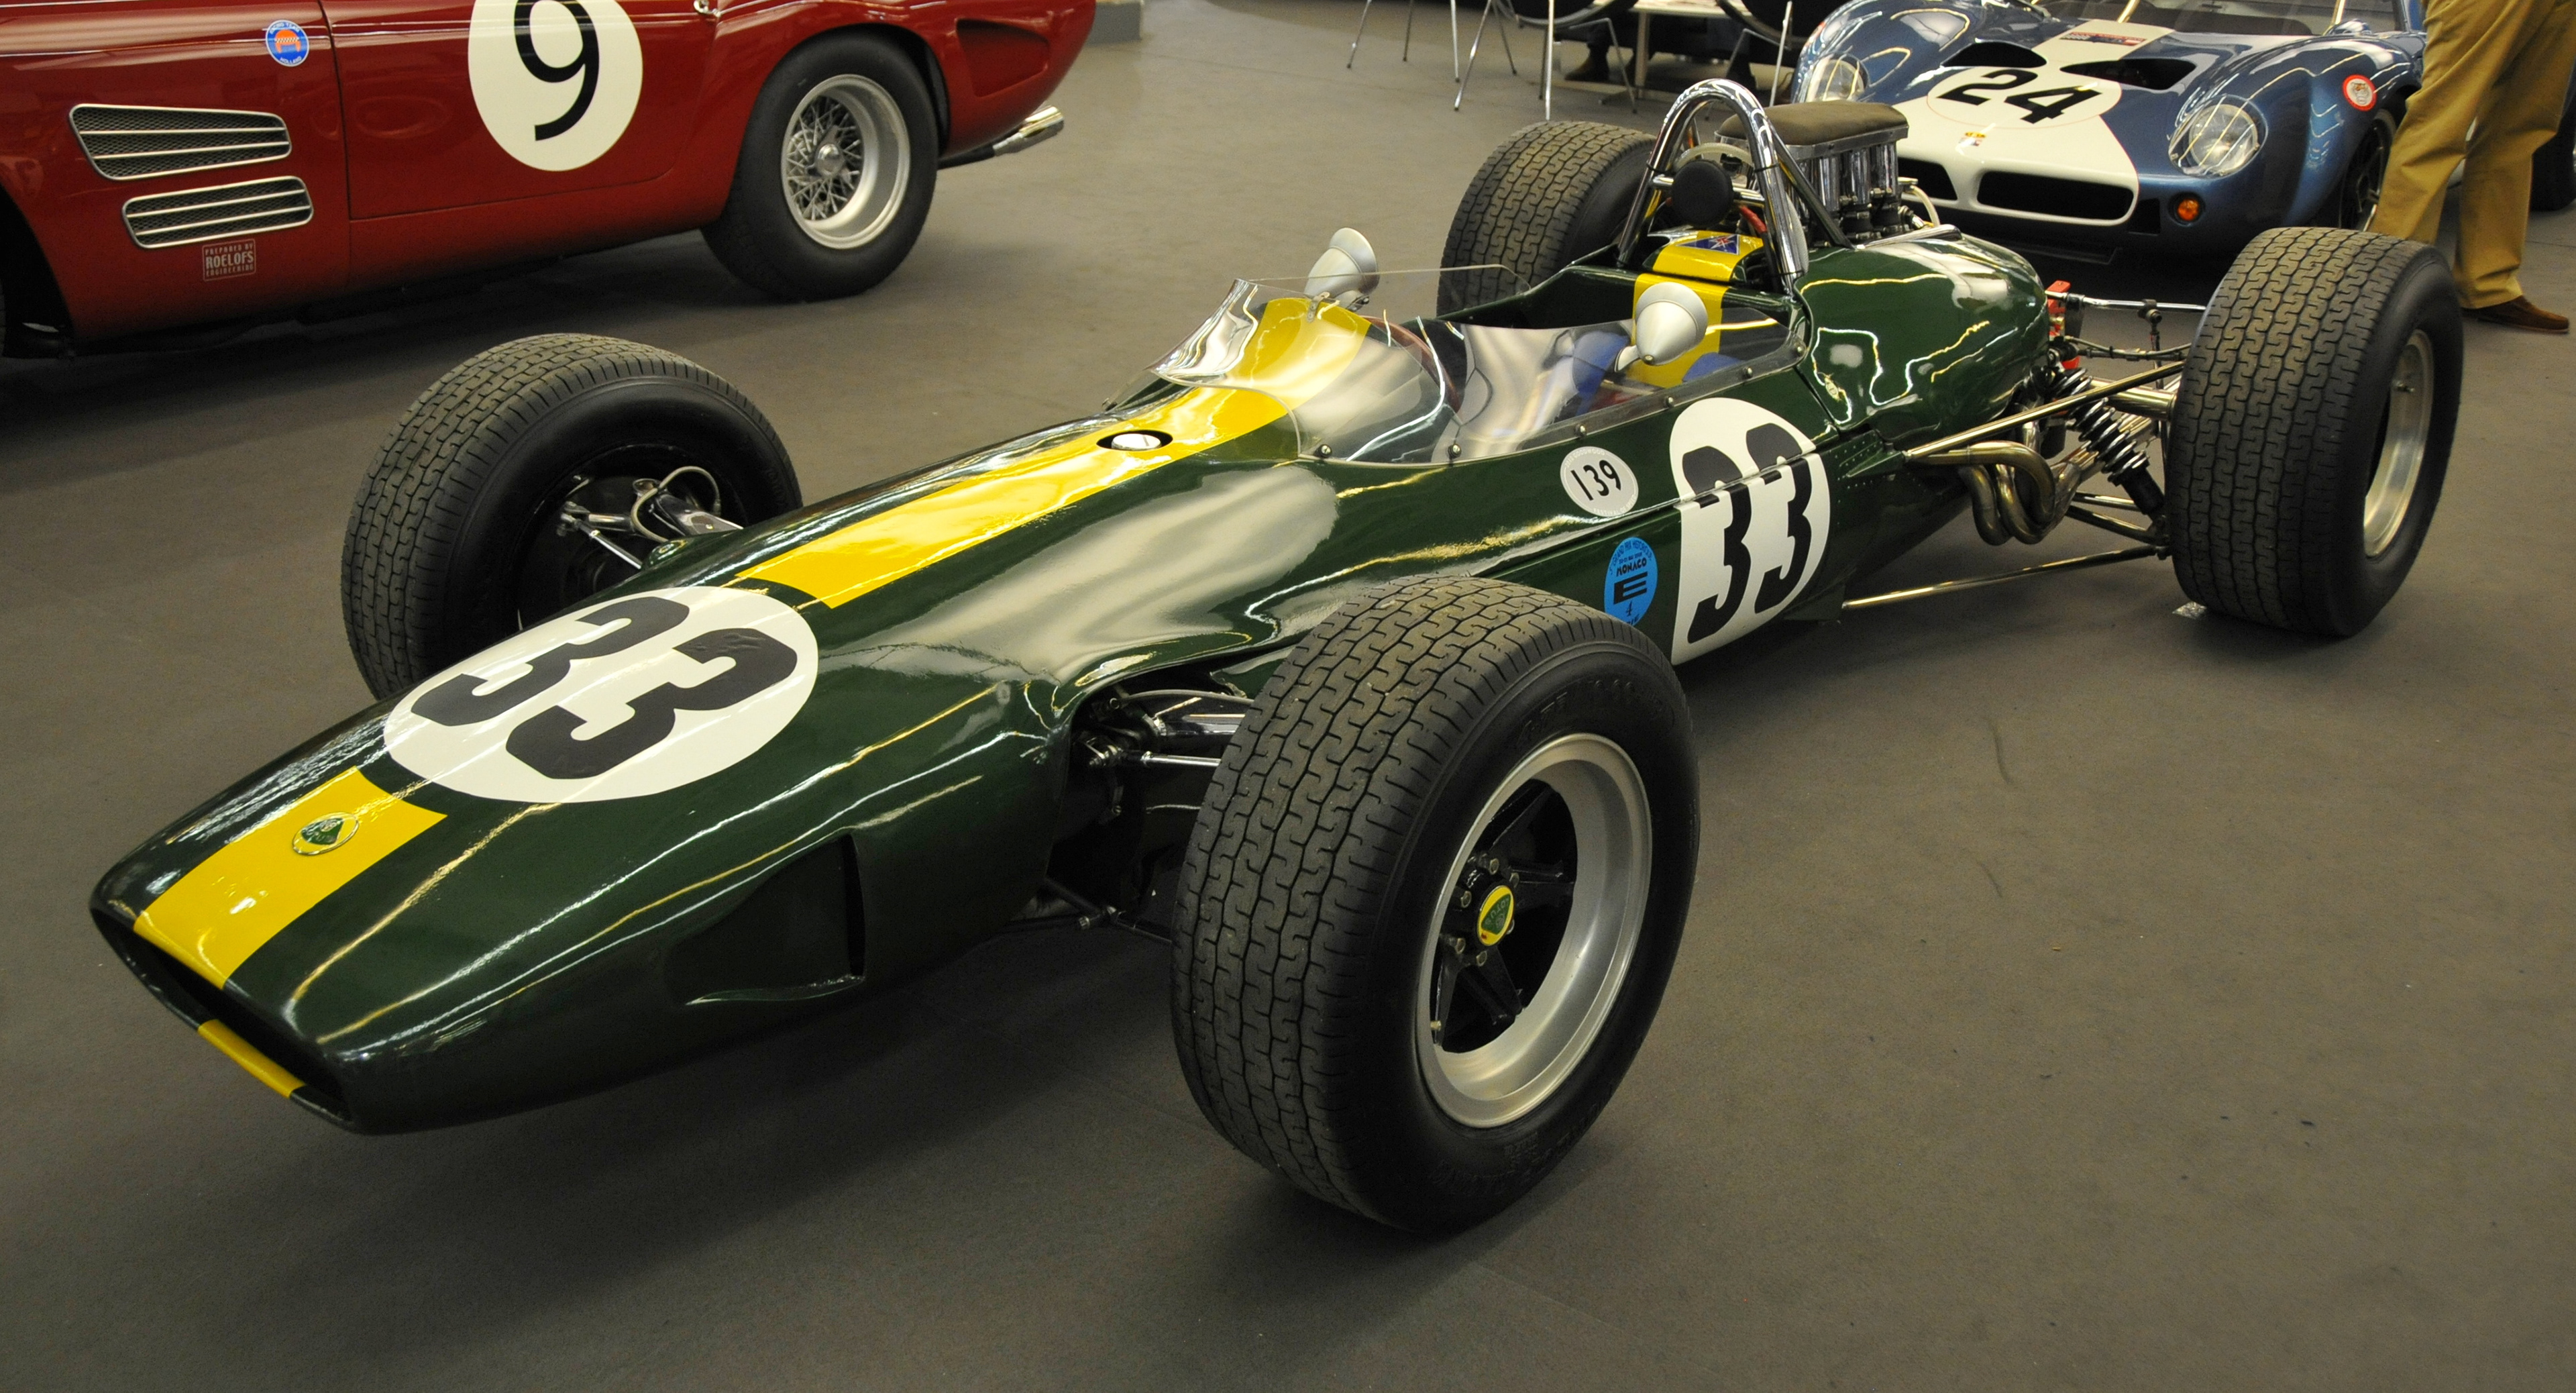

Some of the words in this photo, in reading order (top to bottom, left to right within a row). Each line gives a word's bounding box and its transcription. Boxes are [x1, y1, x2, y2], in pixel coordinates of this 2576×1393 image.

[514, 0, 600, 142] 9
[1935, 68, 2103, 125] 24
[205, 244, 241, 256] PREPARED
[206, 251, 254, 270] ROELOFS
[206, 264, 254, 278] ENGINEERING
[1572, 449, 1605, 459] GOODWOOD
[1570, 460, 1621, 501] 139
[1682, 422, 1813, 644] 33
[1616, 557, 1647, 577] MONACO
[1613, 571, 1648, 605] E
[411, 597, 797, 780] 33
